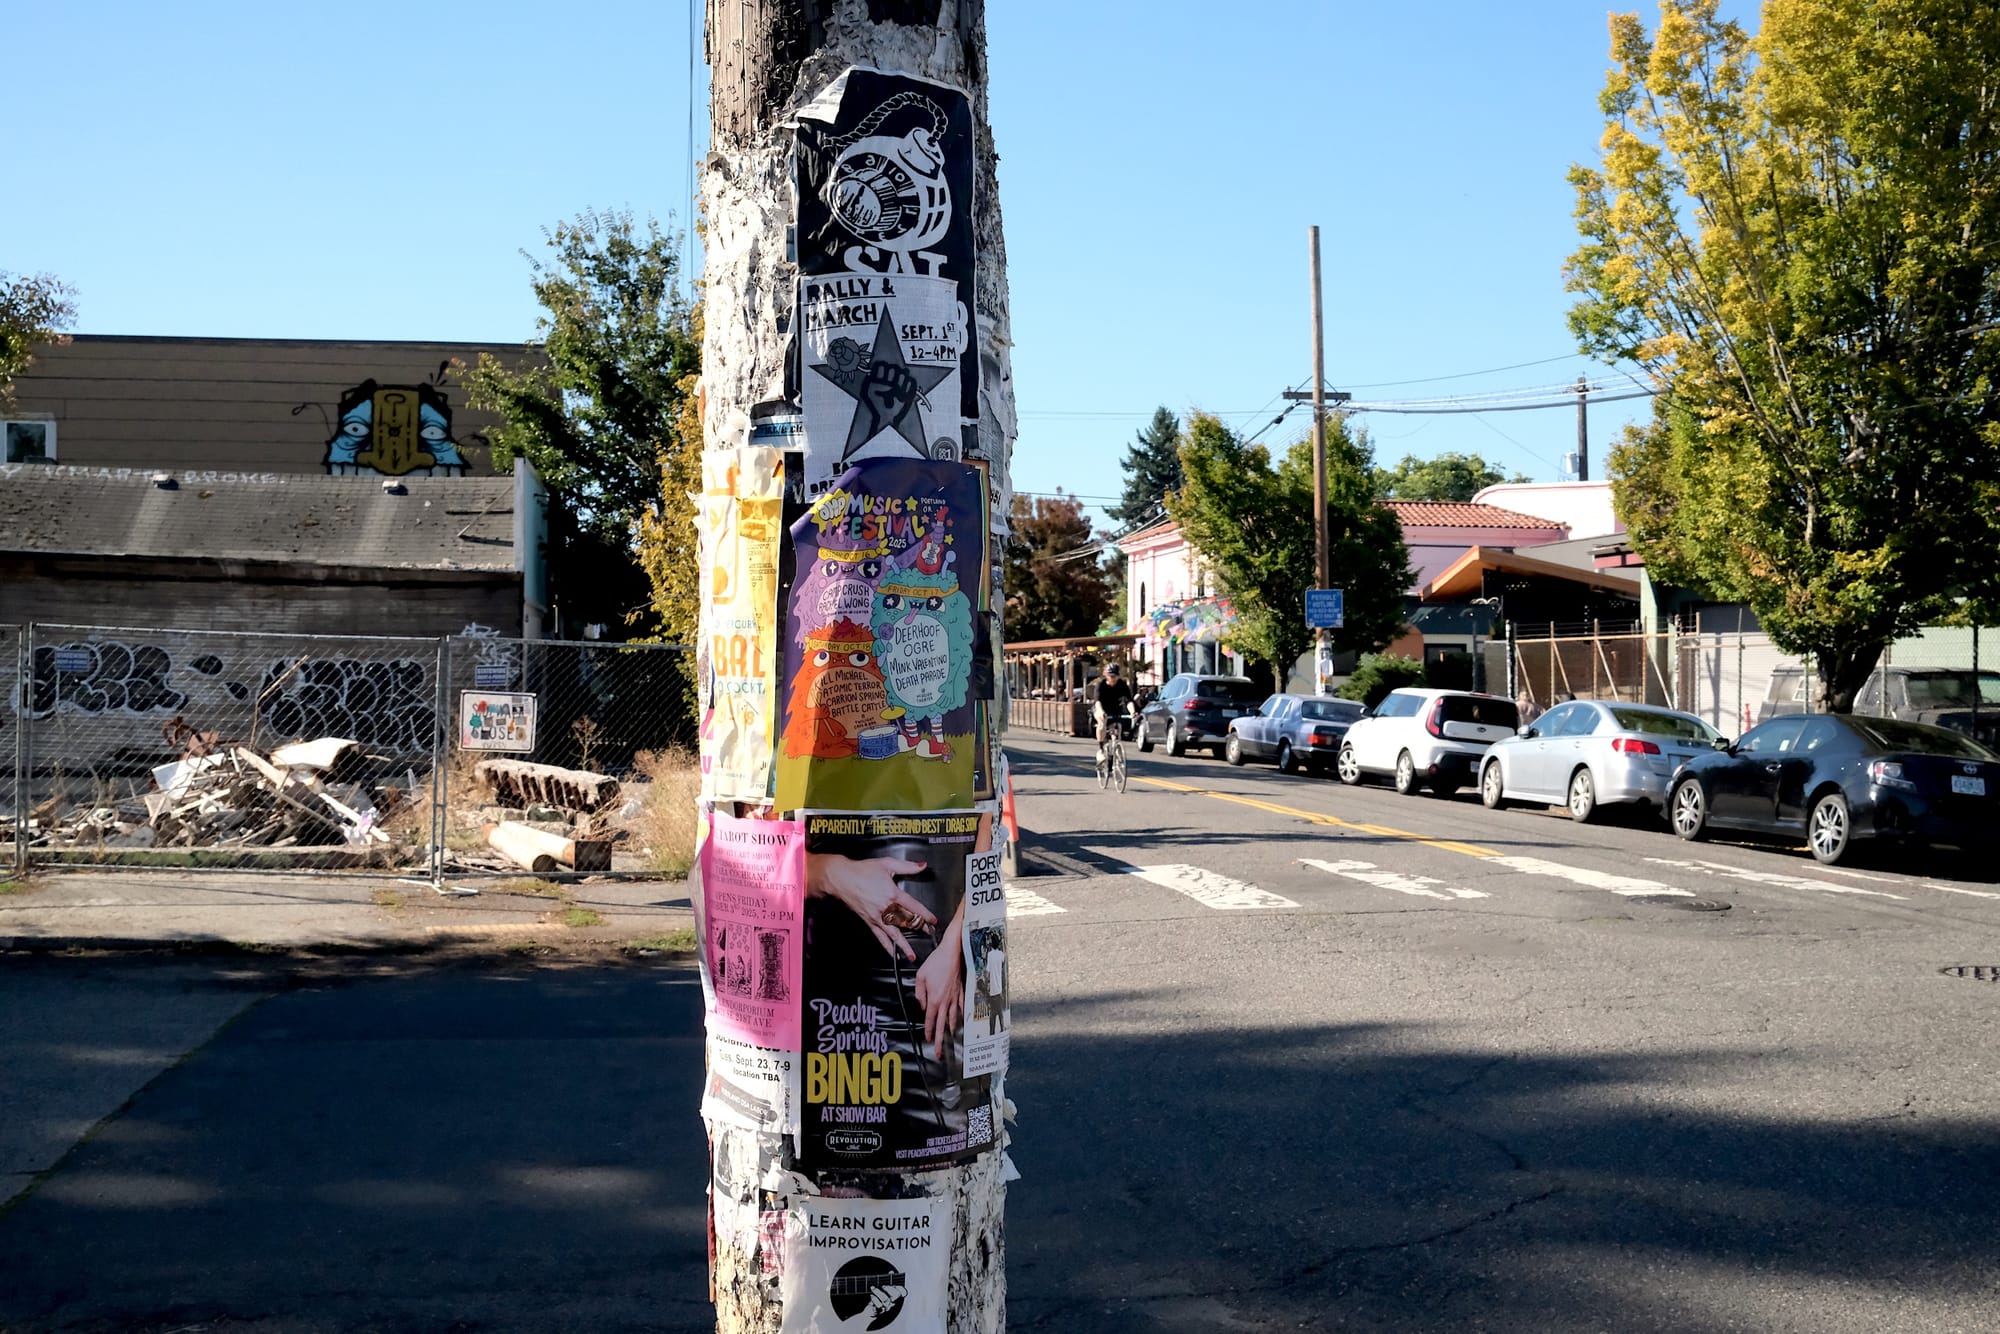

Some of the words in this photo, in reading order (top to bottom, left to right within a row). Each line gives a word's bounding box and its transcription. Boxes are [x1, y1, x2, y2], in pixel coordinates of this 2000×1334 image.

[843, 245, 948, 279] SAT
[806, 278, 871, 303] RALLY
[882, 278, 895, 295] &
[805, 303, 878, 330] MARCH
[901, 325, 938, 340] SEPT.
[910, 345, 957, 360] 12-4PM
[845, 494, 902, 516] MUSIC
[920, 497, 946, 506] PORTLAND
[837, 514, 925, 544] FESTIVAL
[888, 537, 907, 548] 2025
[842, 583, 870, 597] CRUSH
[888, 585, 910, 594] FRIDAY
[912, 588, 927, 597] OCT
[843, 598, 870, 609] WONG
[895, 624, 940, 645] DEERHOOF
[844, 642, 860, 651] OCT
[862, 643, 871, 651] 18
[904, 640, 935, 656] OGRE
[889, 658, 911, 675] MINK
[912, 654, 947, 671] VALENTINO
[815, 671, 834, 688] KILL
[835, 669, 868, 681] MICHAEL
[895, 676, 919, 692] DEATH
[920, 668, 946, 685] PARADE
[823, 683, 852, 696] ATOMIC
[855, 681, 882, 692] TERROR
[826, 692, 858, 708] CARRION
[859, 690, 886, 702] SPRING
[831, 704, 859, 718] BATTLE
[861, 700, 886, 713] CATTLE
[810, 818, 866, 834] APPARENTLY
[889, 818, 921, 834] SECOND
[945, 817, 965, 833] DRAG
[751, 833, 789, 846] SHOW
[737, 895, 768, 908] FRIDAY
[779, 911, 795, 921] PM
[810, 996, 879, 1032] Peachy
[817, 1025, 888, 1058] Springs
[774, 1060, 791, 1071] 7-9
[733, 1067, 760, 1080] location
[762, 1073, 781, 1082] TBA
[806, 1052, 903, 1105] BINGO
[821, 1106, 834, 1123] AT
[835, 1106, 866, 1123] SHOW
[866, 1106, 887, 1123] BAR
[829, 1136, 878, 1146] REVOLUTION
[809, 1214, 866, 1230] LEARN
[872, 1215, 930, 1231] GUITAR
[809, 1235, 931, 1250] IMPROVISATION
